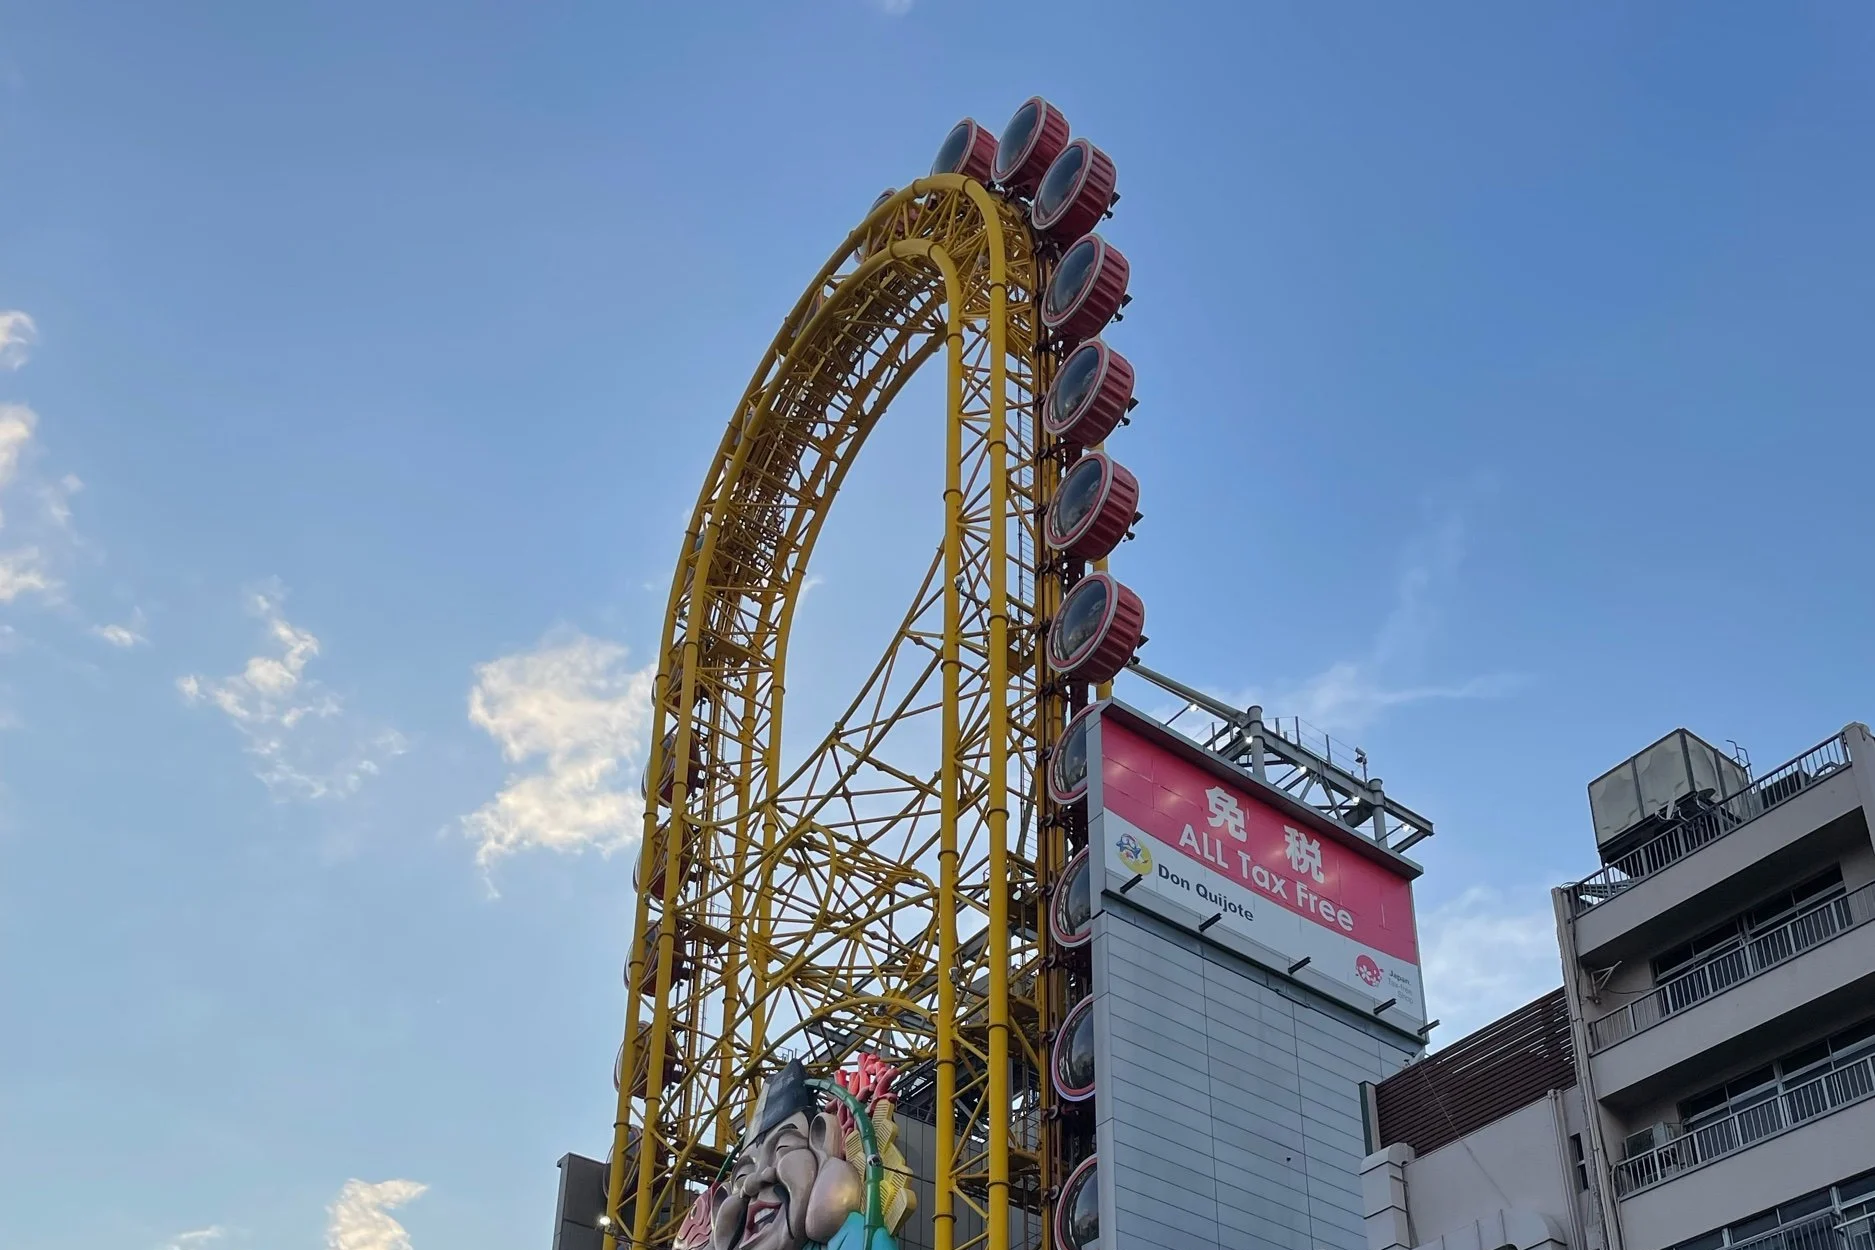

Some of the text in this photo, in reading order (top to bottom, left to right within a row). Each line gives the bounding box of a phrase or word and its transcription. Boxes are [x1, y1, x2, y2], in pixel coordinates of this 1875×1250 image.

[1158, 863, 1254, 922] Don Quijote
[1179, 823, 1354, 932] ALL Tax Free
